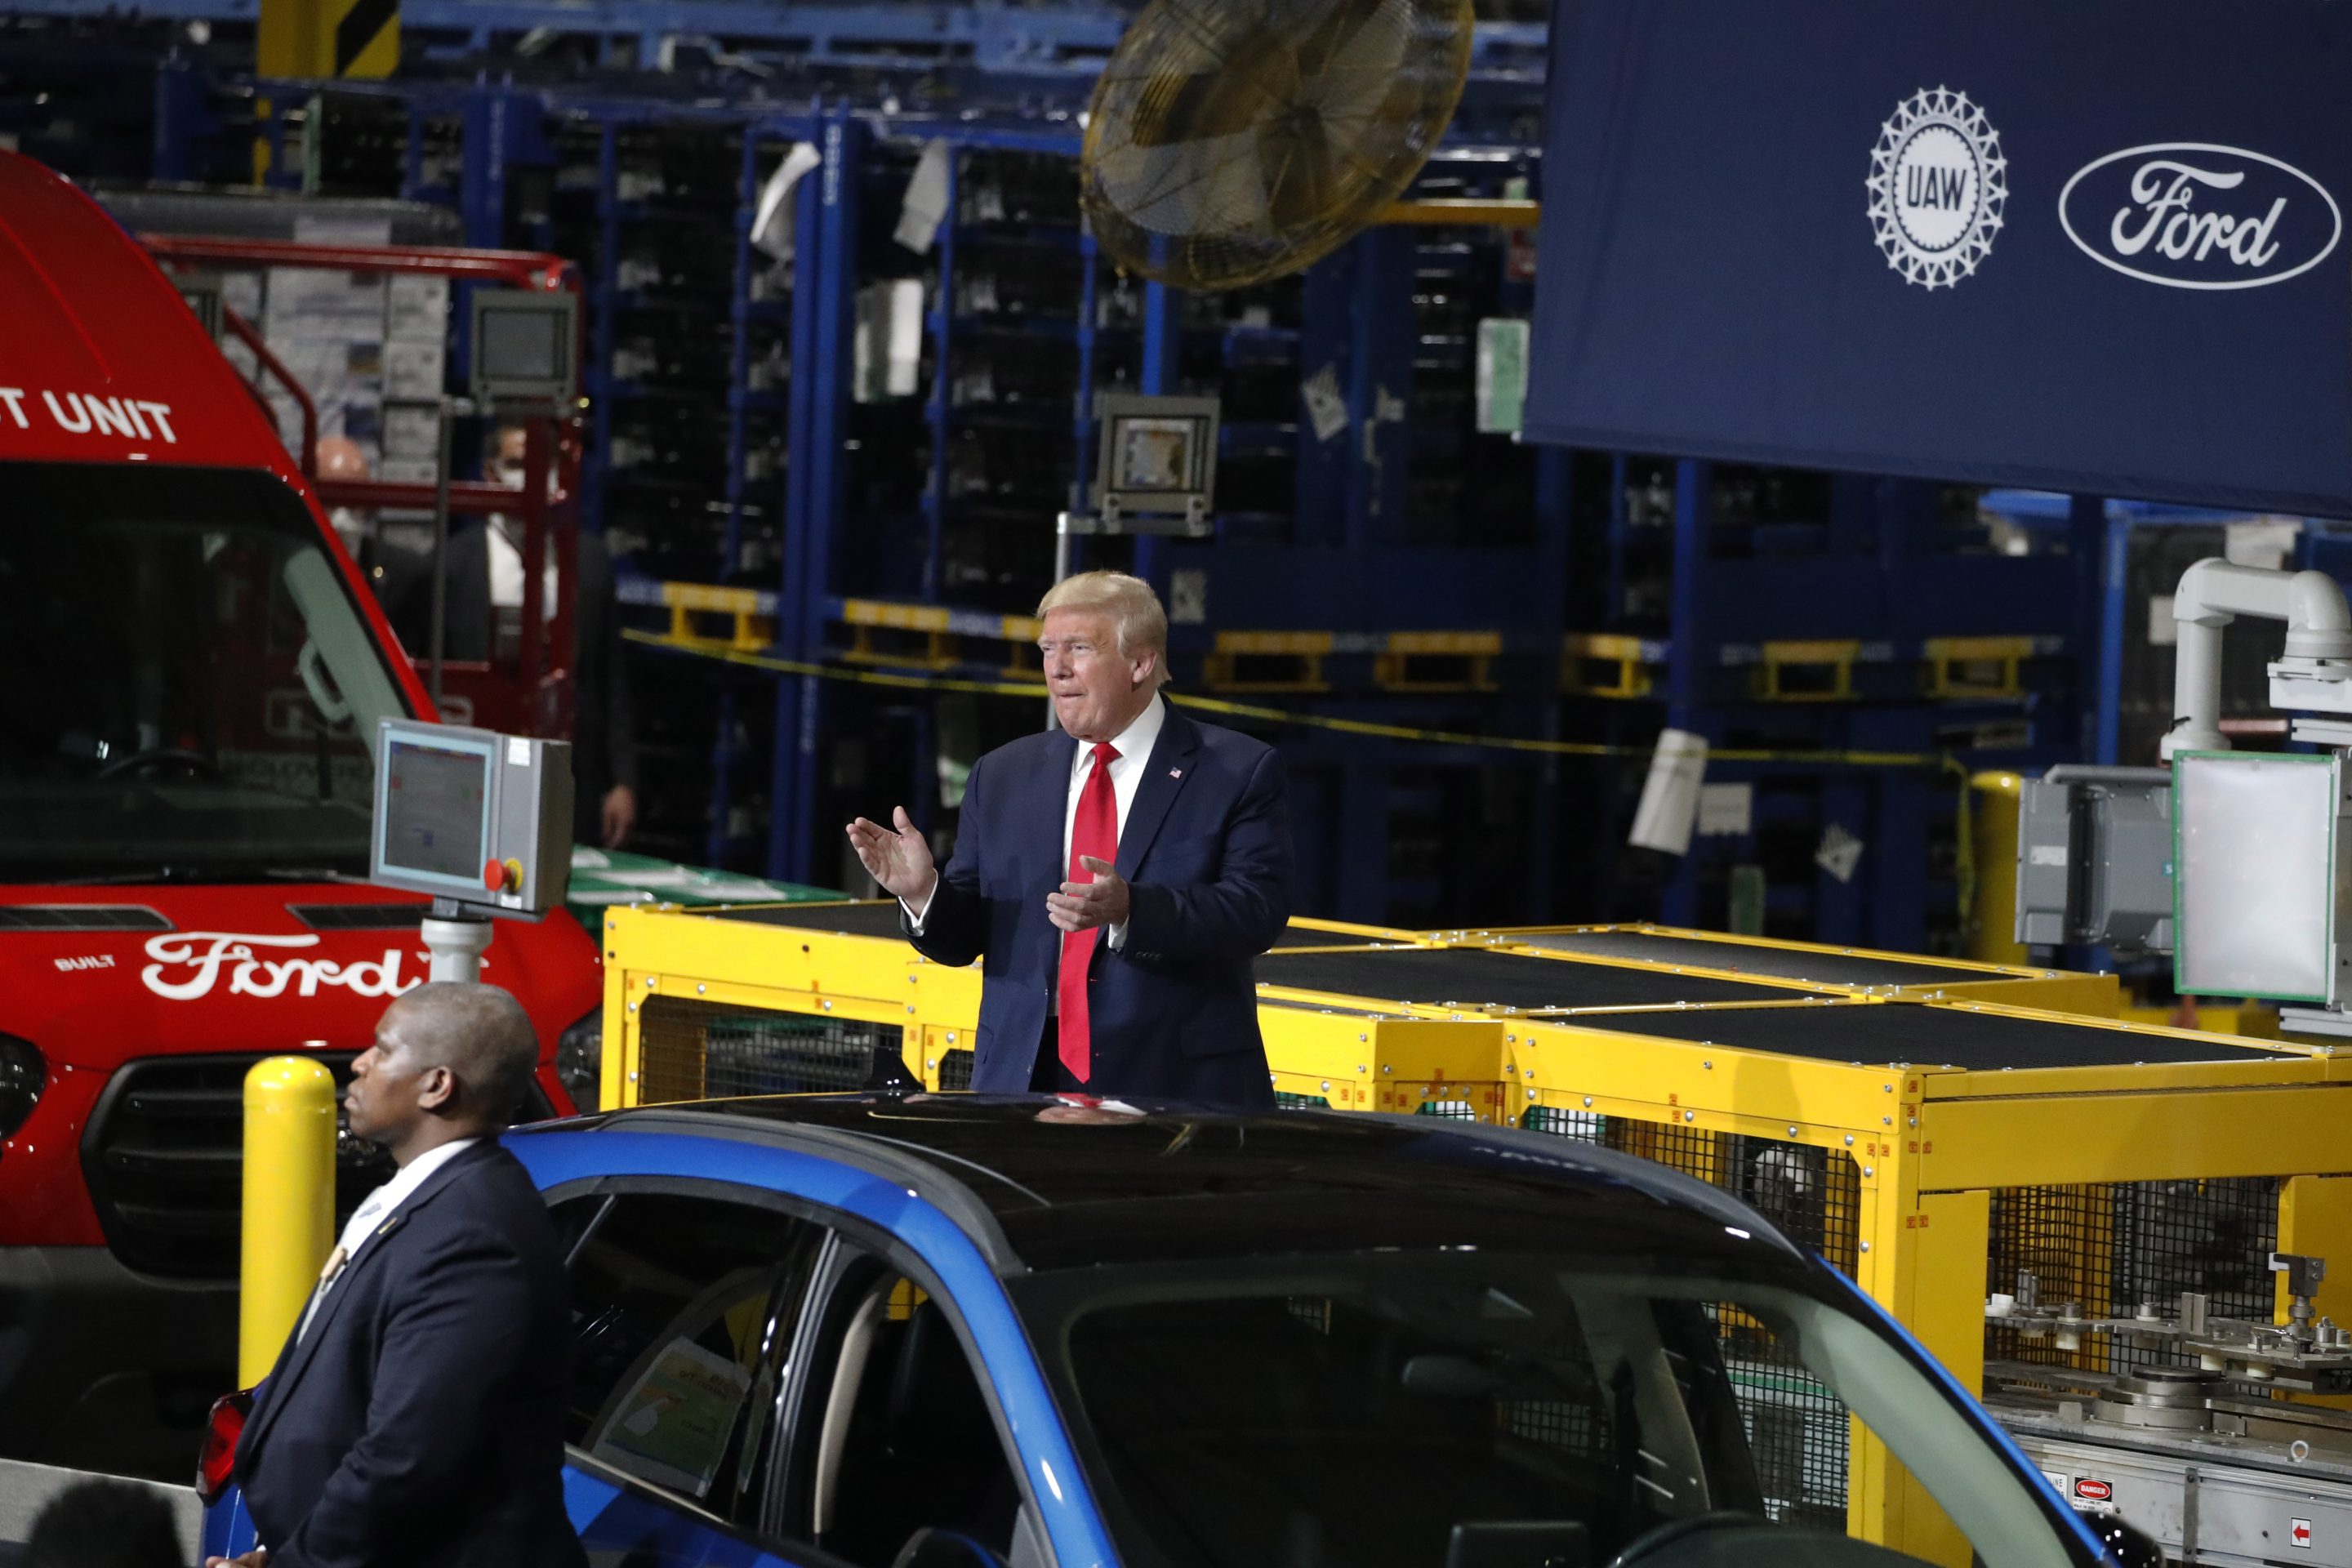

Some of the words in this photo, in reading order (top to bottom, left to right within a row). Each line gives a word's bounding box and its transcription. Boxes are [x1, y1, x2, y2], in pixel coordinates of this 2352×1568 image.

[1908, 166, 1966, 211] UAW
[2111, 160, 2287, 267] Ford
[42, 390, 176, 443] UNIT
[55, 954, 116, 972] BUILT
[141, 931, 421, 1000] Ford
[2081, 1485, 2105, 1494] DANGER
